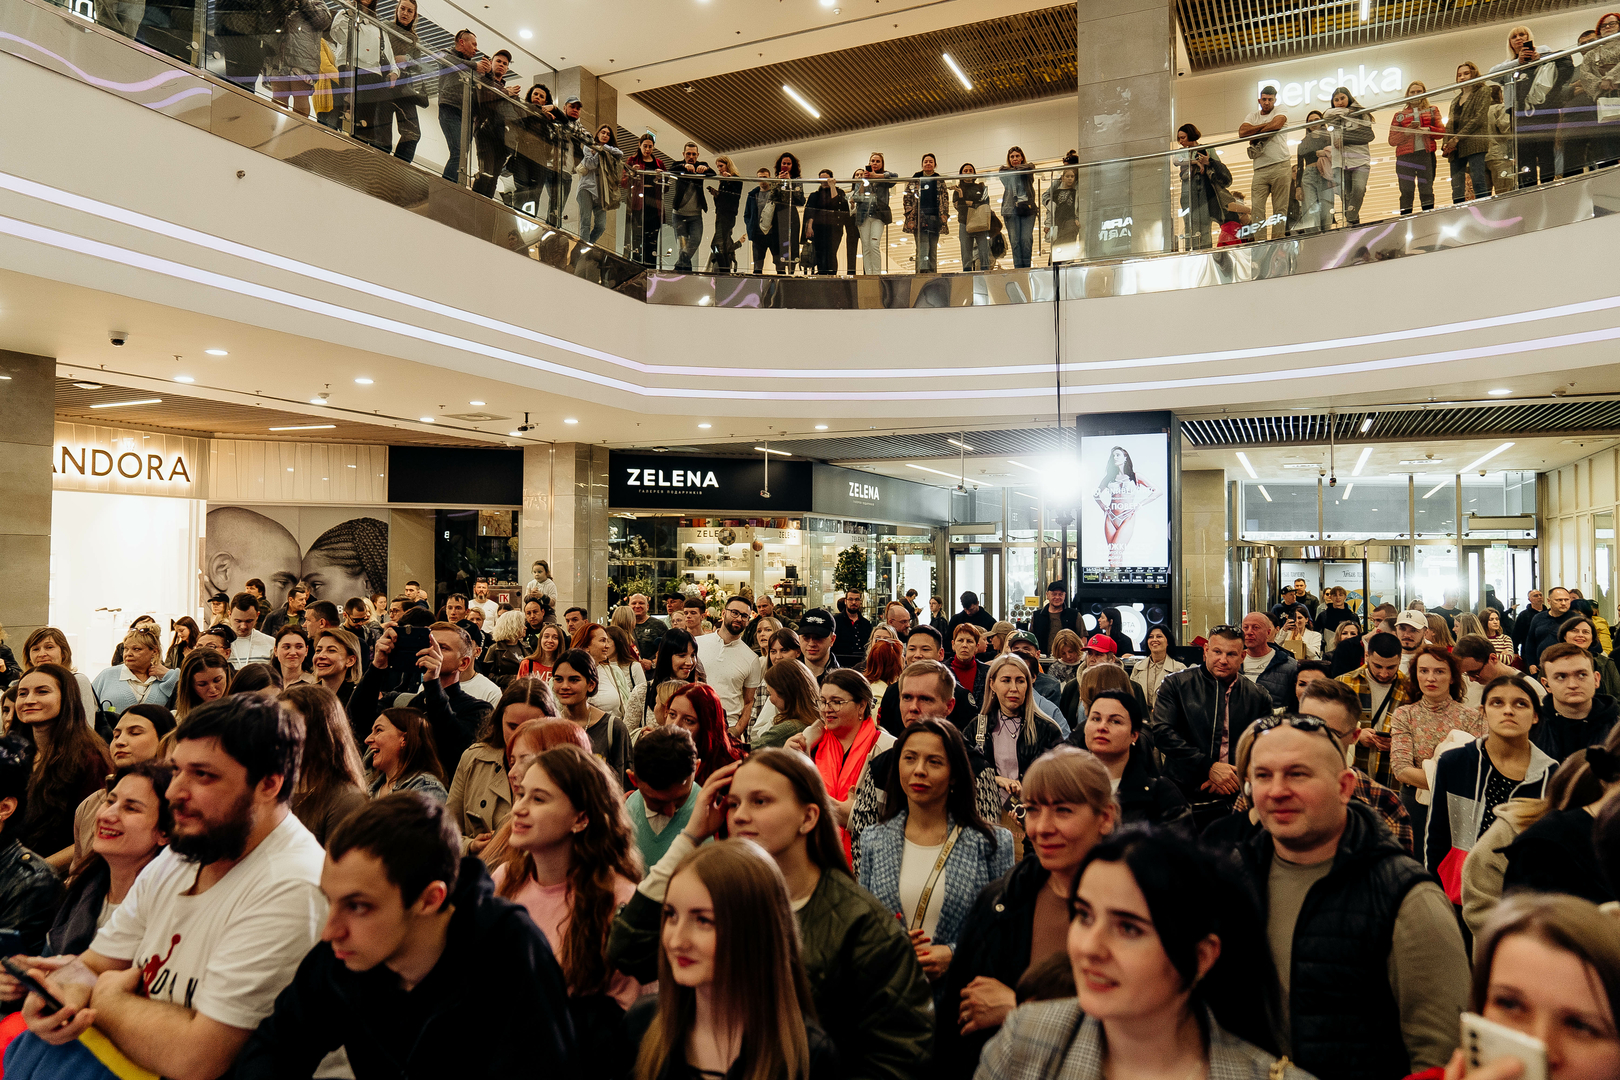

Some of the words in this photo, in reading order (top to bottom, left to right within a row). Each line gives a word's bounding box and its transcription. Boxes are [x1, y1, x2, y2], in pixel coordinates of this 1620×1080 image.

[53, 446, 191, 482] NDORA
[626, 468, 719, 488] ZELENA
[848, 482, 880, 501] ZELENA
[697, 529, 720, 538] ZELE
[499, 594, 509, 603] ПК
